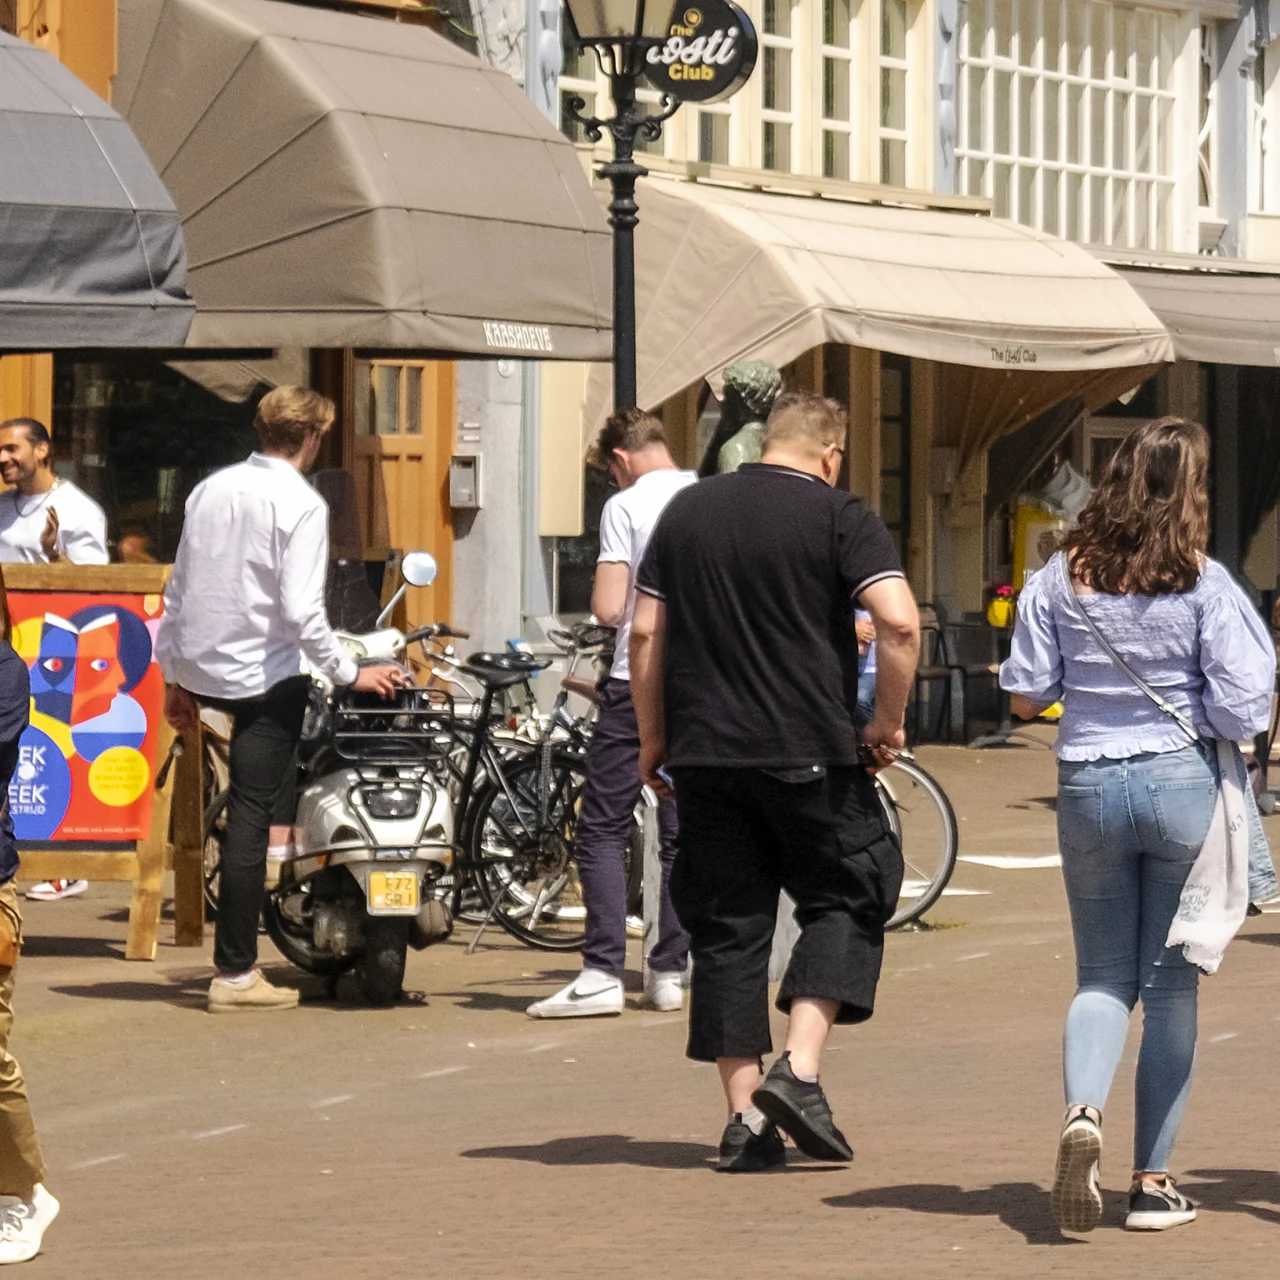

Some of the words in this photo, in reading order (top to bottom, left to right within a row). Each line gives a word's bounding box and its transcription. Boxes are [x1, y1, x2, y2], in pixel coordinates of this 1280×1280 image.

[668, 63, 714, 80] Club
[482, 322, 553, 351] KAASHOEVE
[18, 746, 47, 765] EK
[7, 784, 47, 804] EEK
[11, 805, 46, 815] STRIJD
